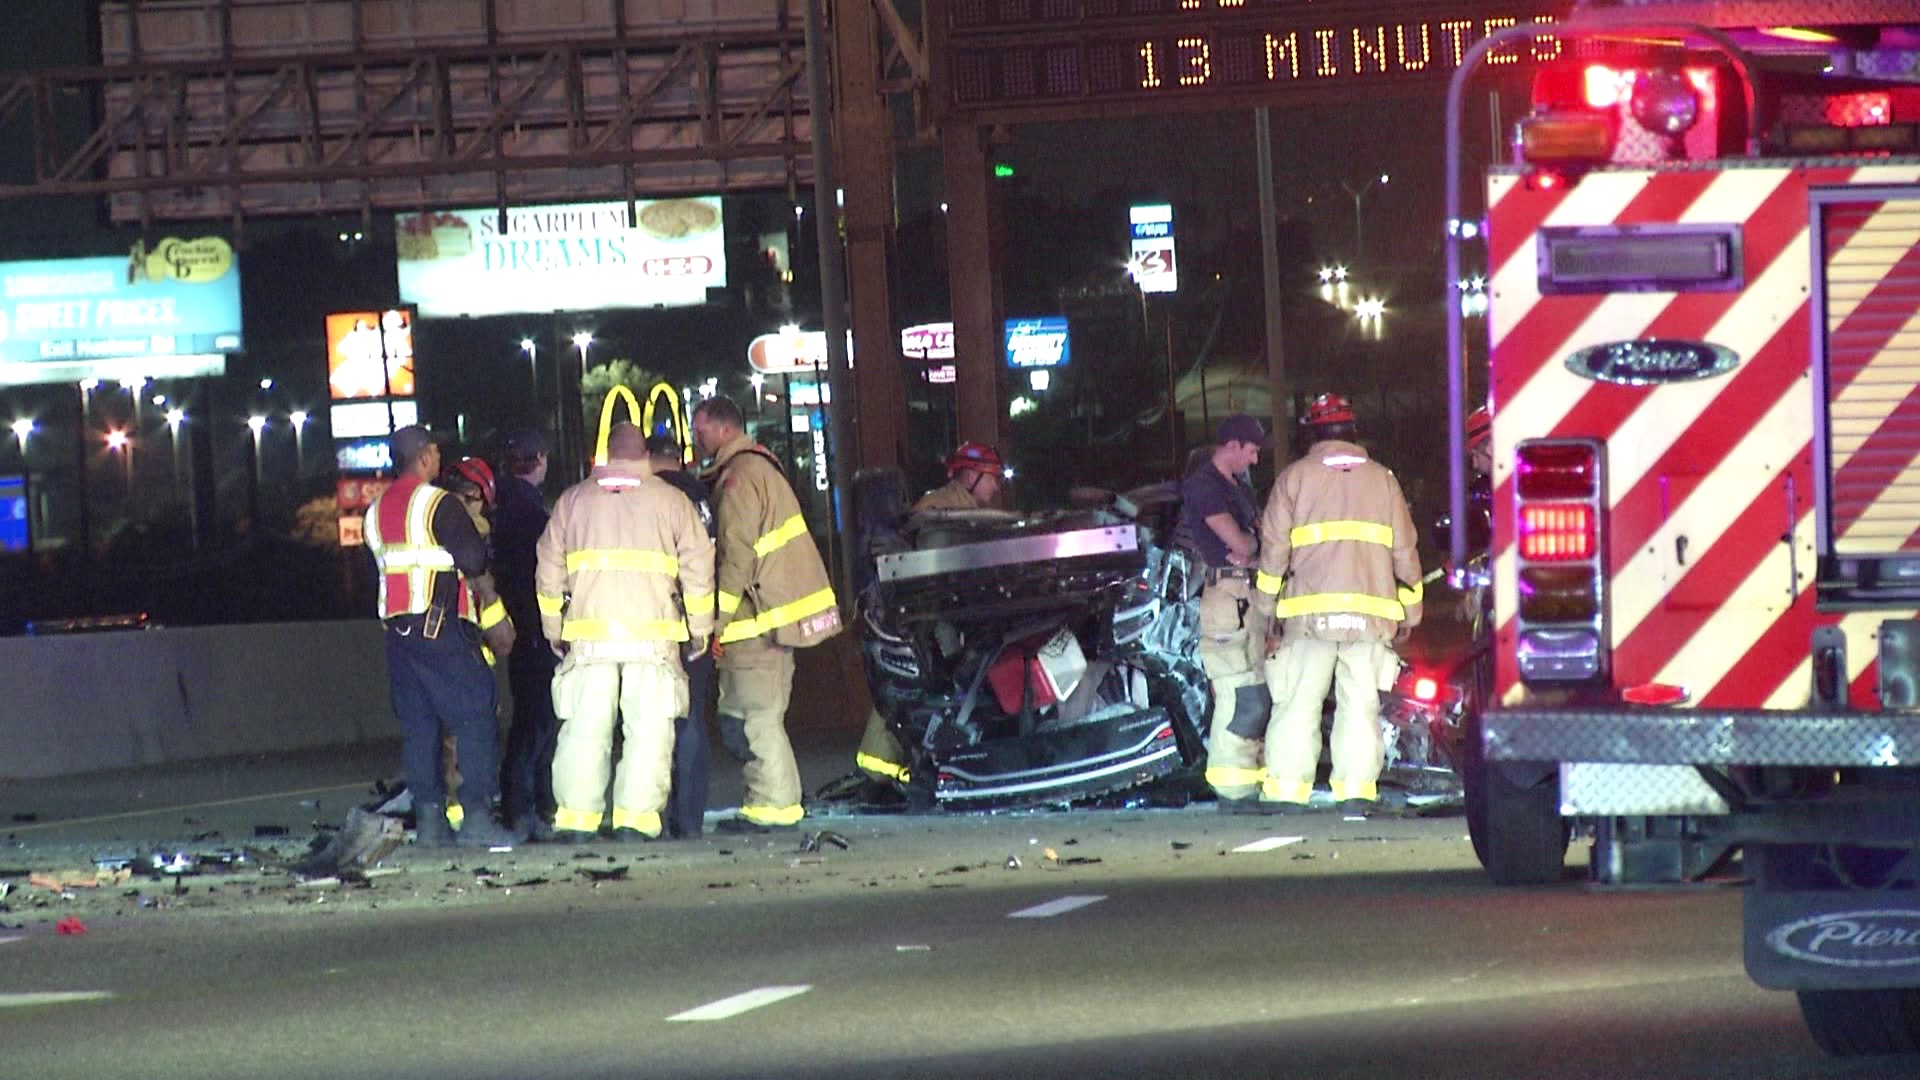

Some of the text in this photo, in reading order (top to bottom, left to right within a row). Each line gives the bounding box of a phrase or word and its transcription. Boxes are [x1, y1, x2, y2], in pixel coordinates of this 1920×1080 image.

[1140, 15, 1563, 89] 13 MINUTES
[480, 208, 626, 237] SGARPLUM
[482, 235, 628, 273] DREAMS
[1808, 920, 1920, 952] Pierc
